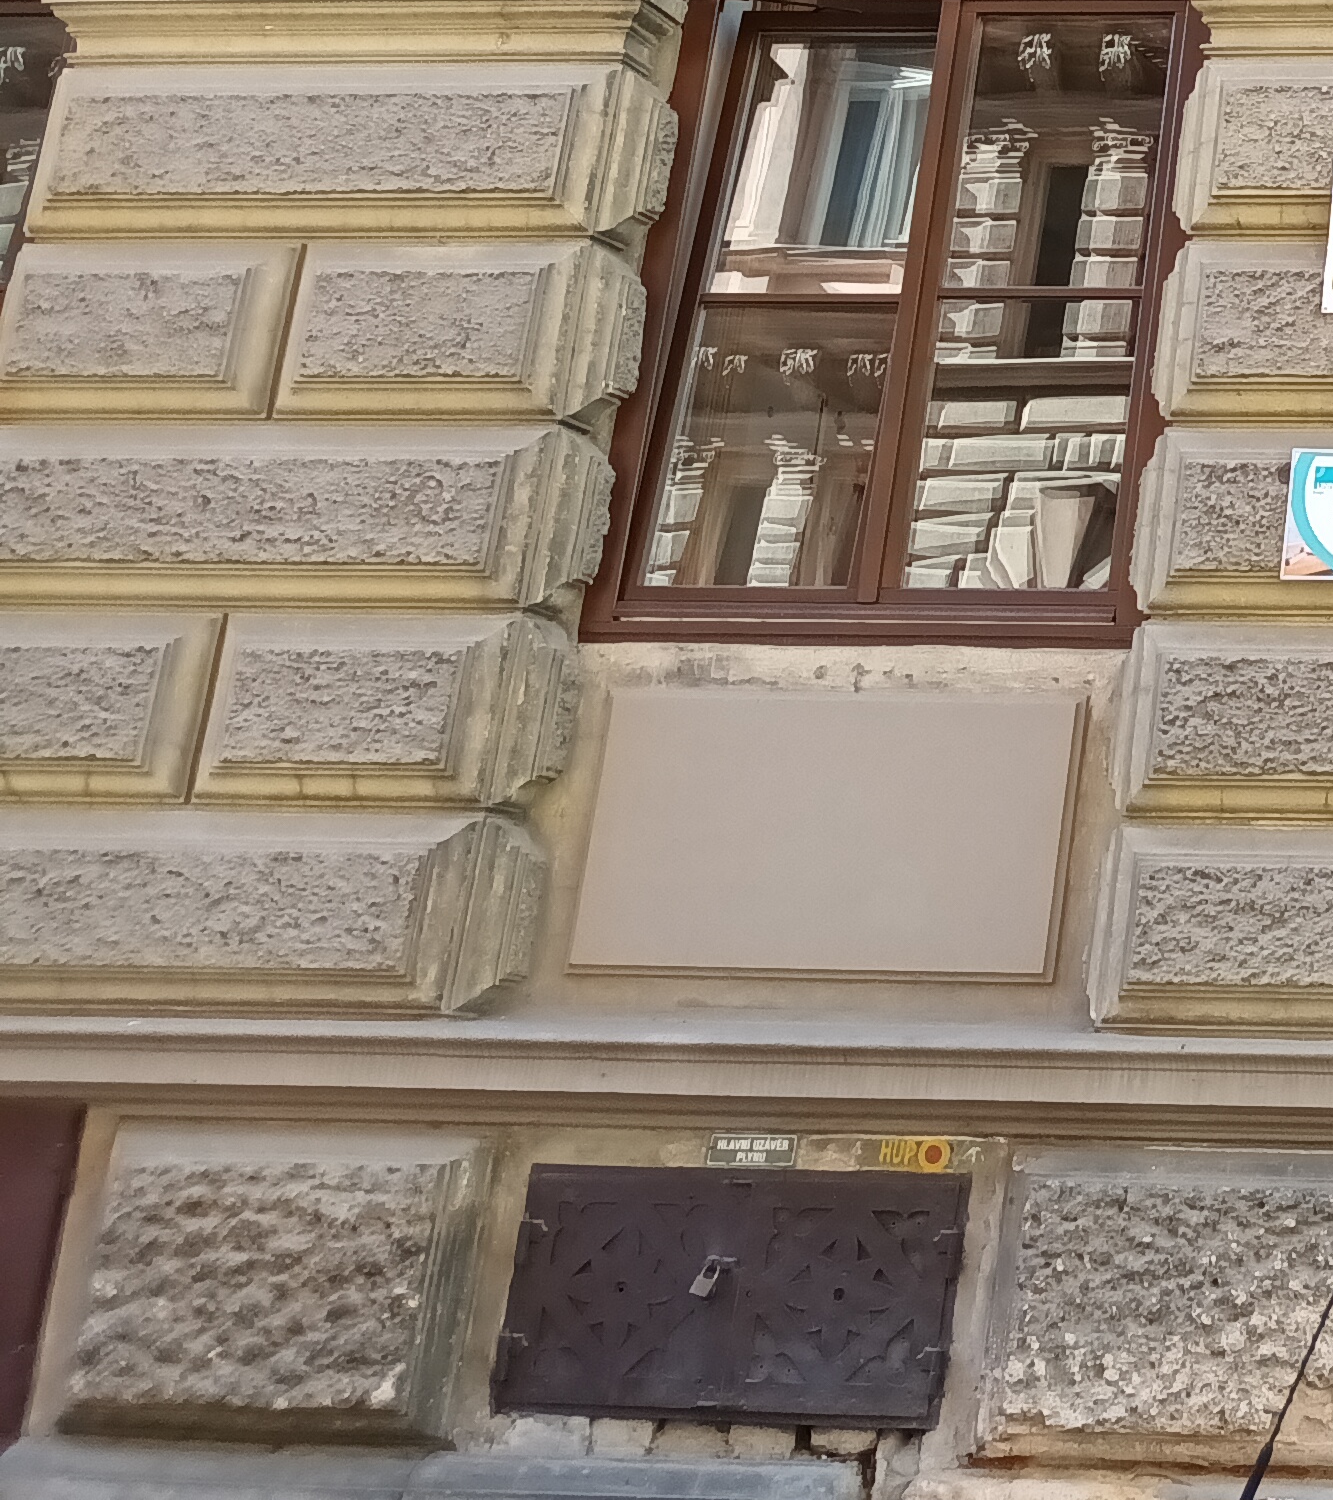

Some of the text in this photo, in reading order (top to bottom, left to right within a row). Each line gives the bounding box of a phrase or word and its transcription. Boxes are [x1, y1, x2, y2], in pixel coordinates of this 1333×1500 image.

[716, 1137, 752, 1150] HLAVNÍ
[735, 1151, 767, 1163] PLYNU
[878, 1138, 918, 1166] HUP
